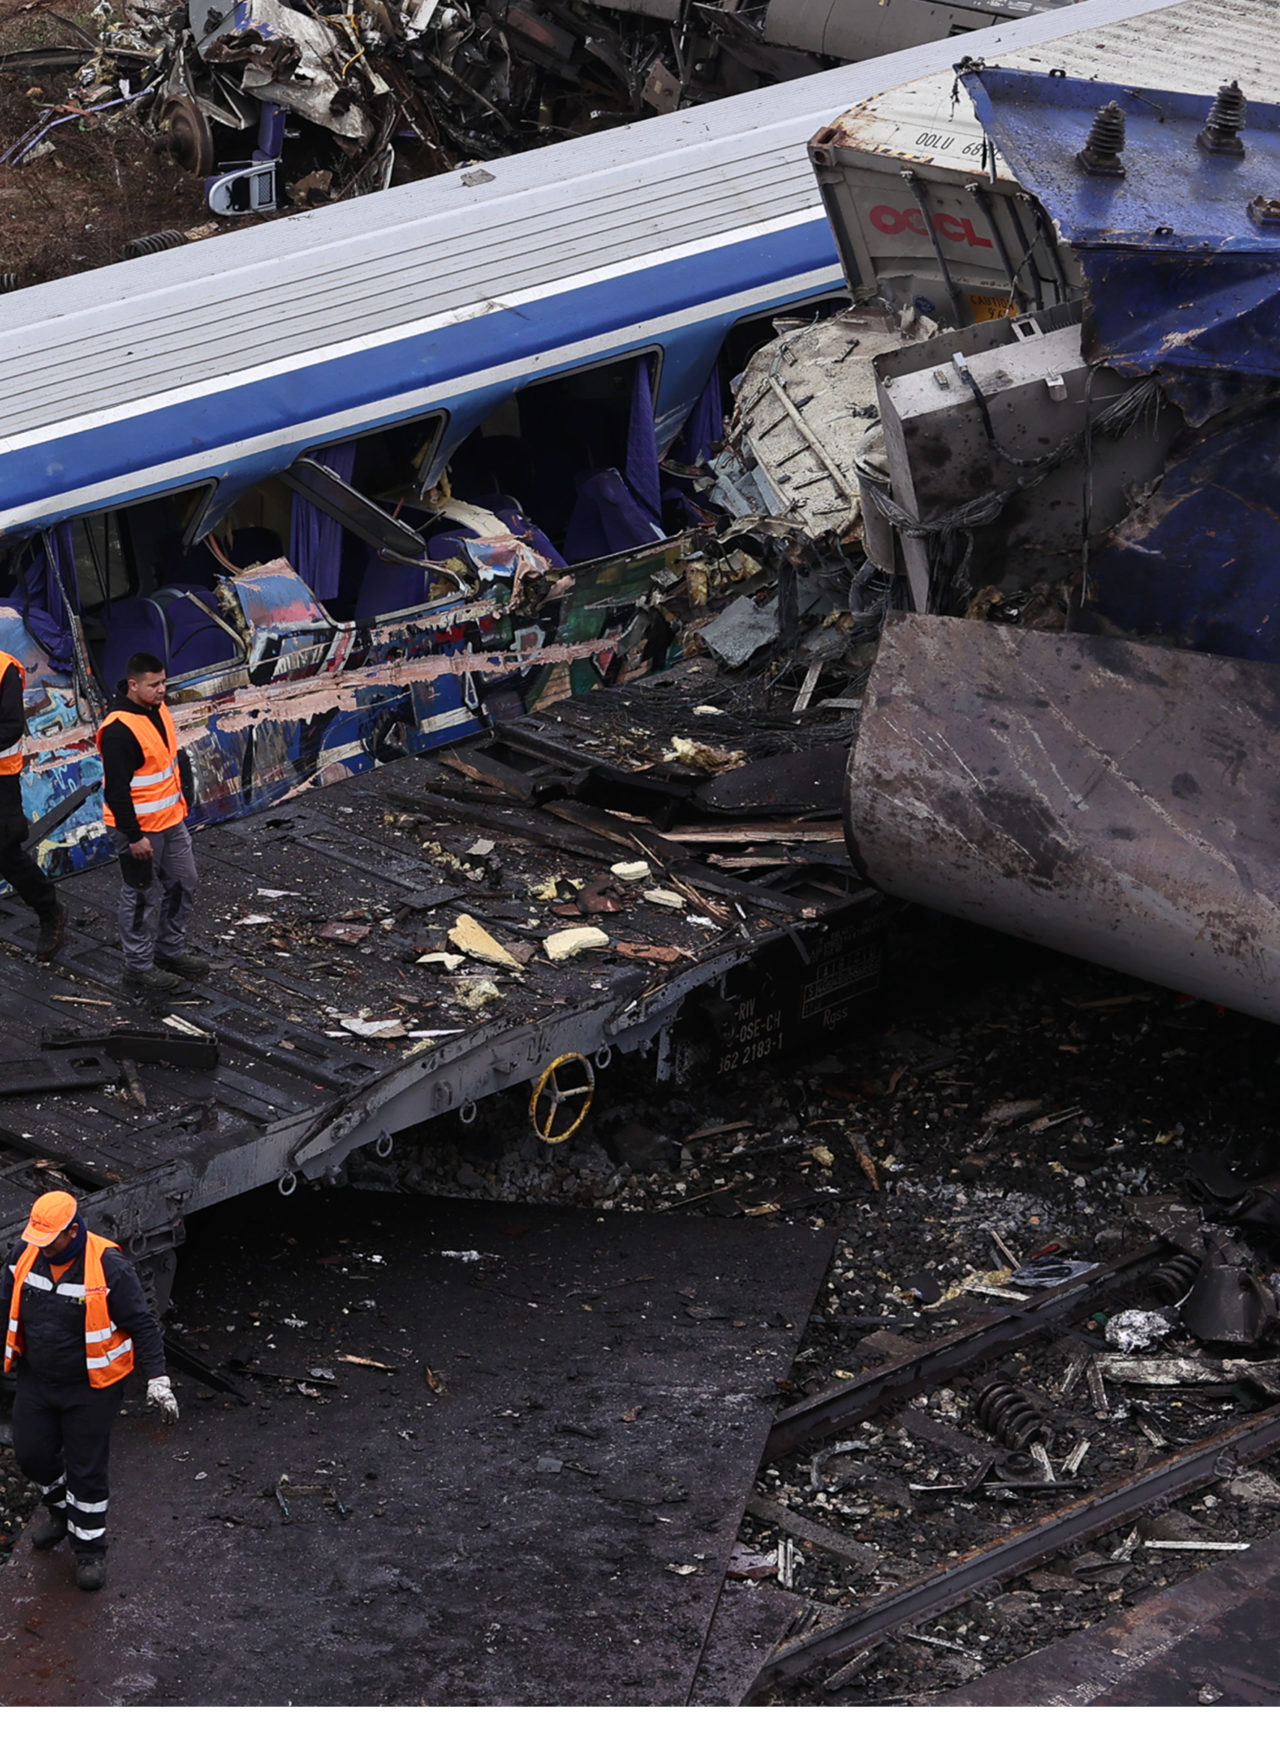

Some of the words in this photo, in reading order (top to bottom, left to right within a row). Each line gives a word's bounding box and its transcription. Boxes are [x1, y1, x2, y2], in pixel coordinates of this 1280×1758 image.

[915, 132, 955, 150] OOLU
[869, 204, 994, 249] OOCL
[742, 1032, 783, 1065] 2183-1
